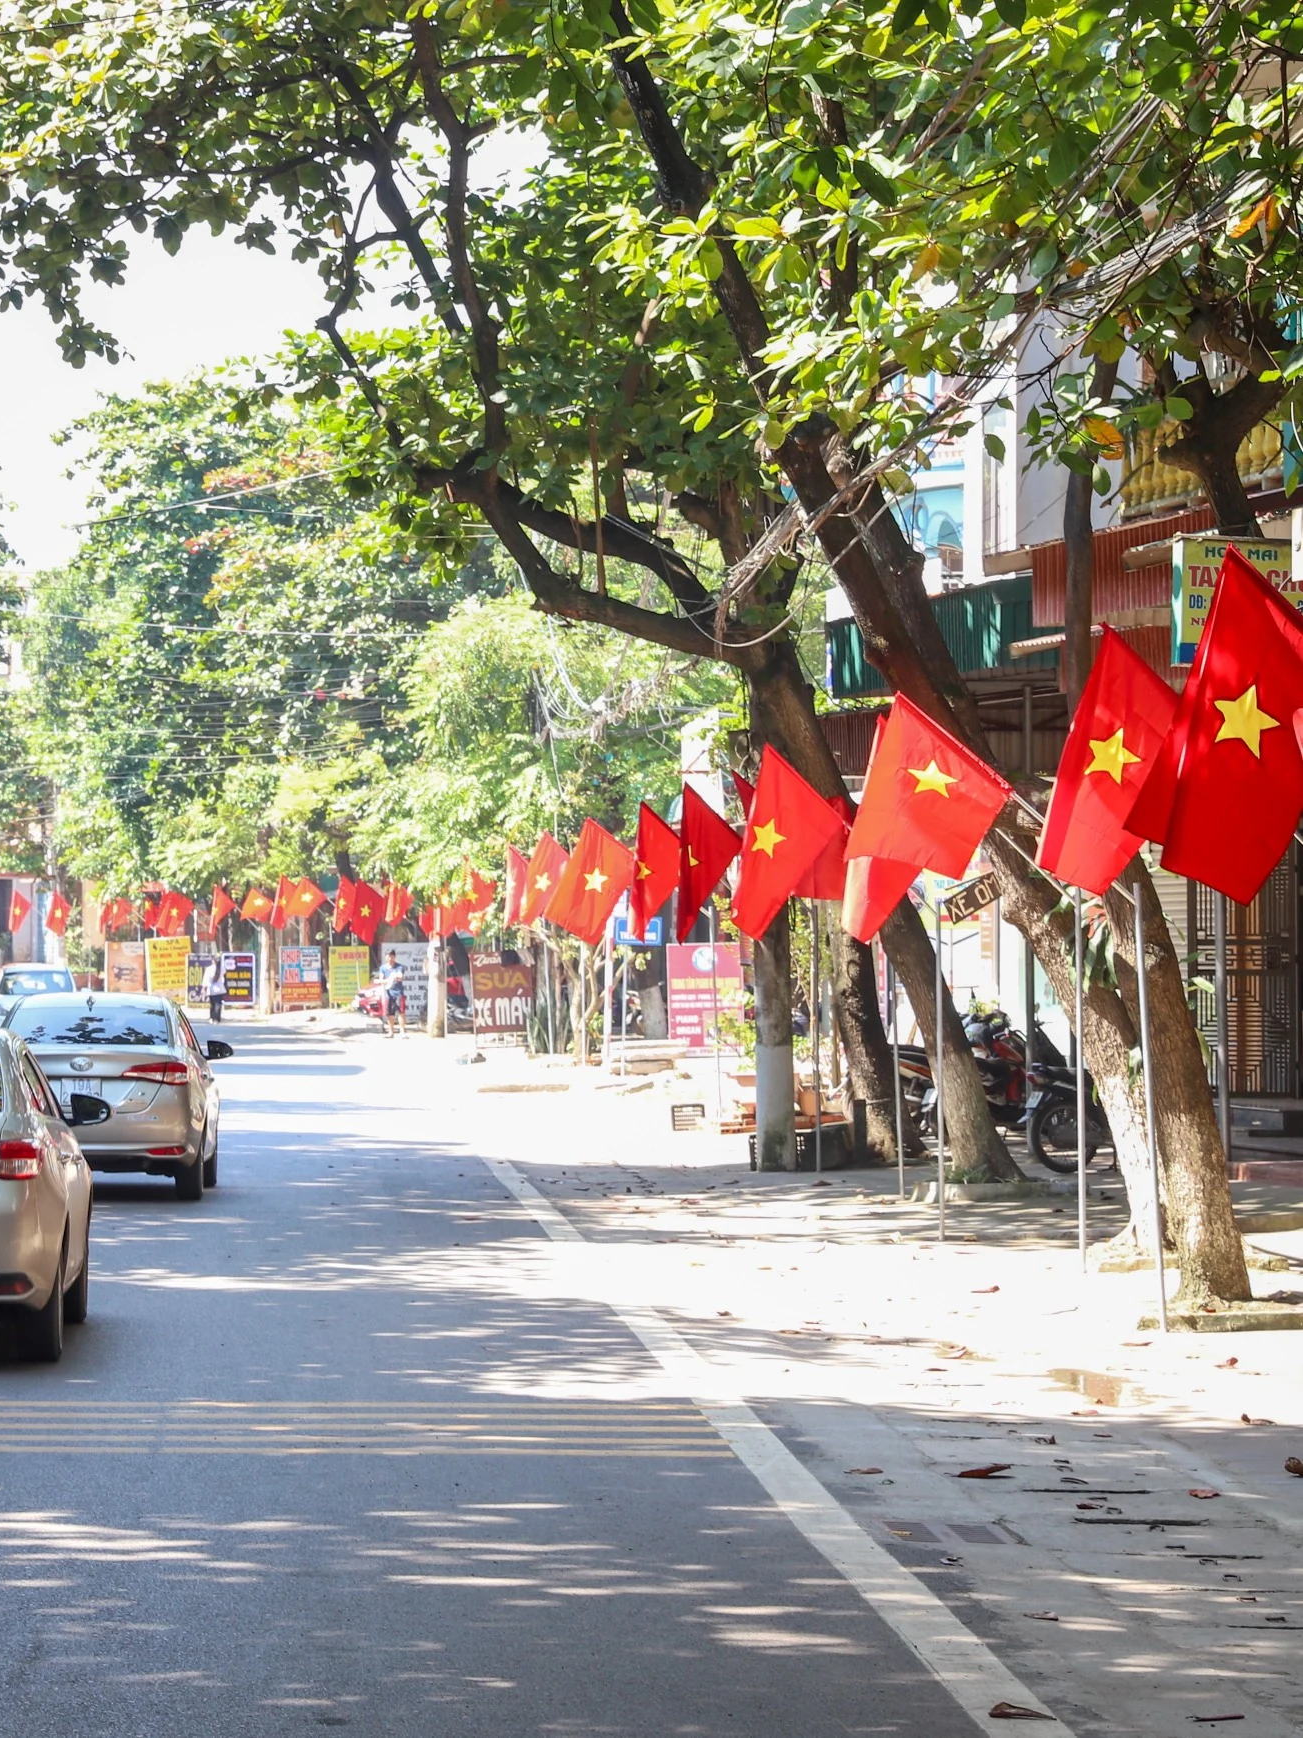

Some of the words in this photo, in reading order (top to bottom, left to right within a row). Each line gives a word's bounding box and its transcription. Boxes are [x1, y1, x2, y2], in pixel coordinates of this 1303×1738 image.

[1247, 548, 1278, 561] MAI
[948, 891, 975, 923] XE
[473, 996, 494, 1028] XE
[494, 988, 532, 1026] MÁY
[72, 1078, 92, 1092] 19A
